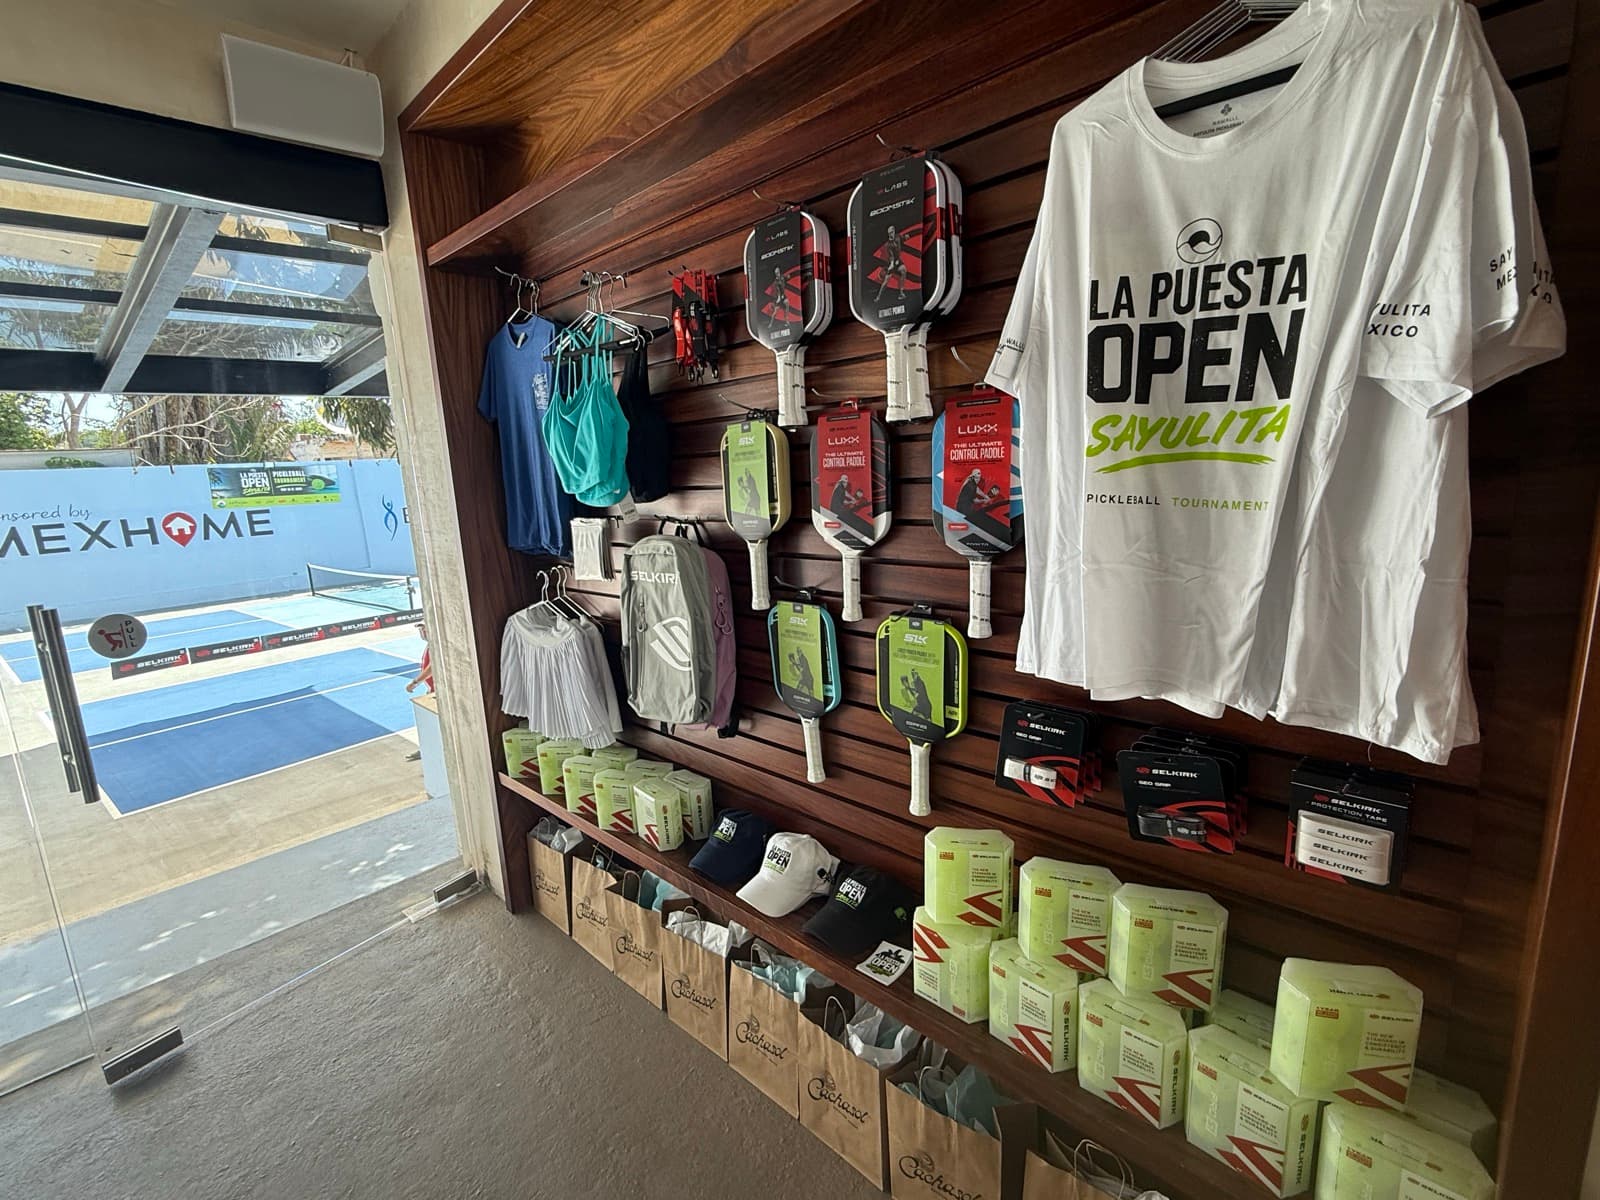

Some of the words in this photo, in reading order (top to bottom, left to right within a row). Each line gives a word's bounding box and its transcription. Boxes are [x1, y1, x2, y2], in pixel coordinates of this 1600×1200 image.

[1089, 276, 1135, 320] LA
[1148, 253, 1307, 318] PUESTA
[1375, 303, 1431, 316] ULITA
[1087, 308, 1306, 404] OPEN
[958, 423, 998, 435] LUXX
[1085, 404, 1291, 458] SAYULITA
[828, 436, 859, 446] LUXX
[823, 457, 846, 468] CONTROL
[846, 456, 866, 467] PADDLE
[950, 449, 979, 461] CONTROL
[980, 447, 1006, 459] PADDLE
[241, 477, 270, 488] OPEN
[1086, 493, 1160, 505] PICKLEBALL
[1172, 497, 1270, 511] TOURNAMENT
[69, 504, 91, 520] by
[125, 620, 138, 648] PULL
[904, 633, 929, 644] SLK
[137, 654, 183, 668] SELKIRK
[1029, 722, 1067, 736] SELKIRK
[1152, 768, 1198, 778] SELKIRK
[1311, 801, 1363, 817] PROTECTION
[1365, 813, 1388, 823] TAPE
[1331, 798, 1383, 814] SELKIRK
[1318, 828, 1375, 846] SELKIRK
[767, 850, 790, 868] OPEN
[1313, 842, 1370, 861] SELKIRK
[1309, 856, 1365, 875] SELKIRK
[839, 882, 868, 904] OPEN
[872, 958, 899, 975] OPEN
[1171, 1067, 1179, 1115] SELKIRK
[1296, 1133, 1306, 1186] SELKIRK
